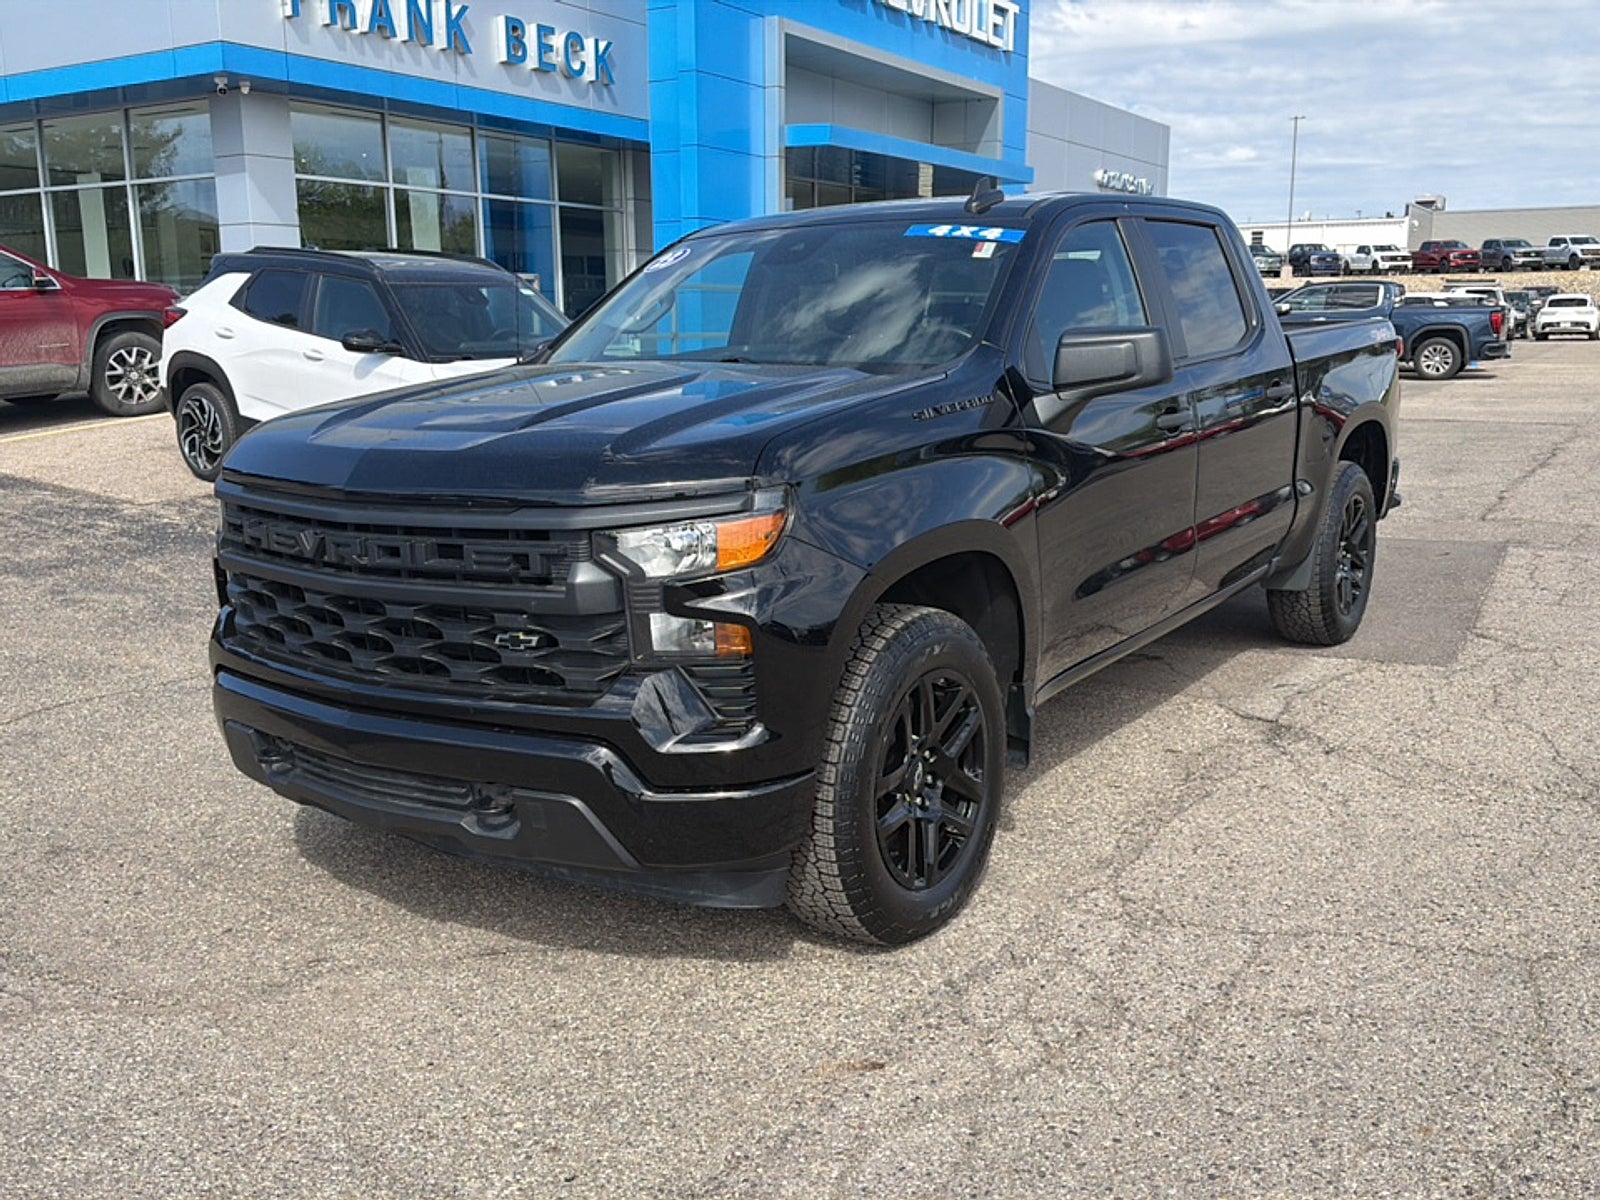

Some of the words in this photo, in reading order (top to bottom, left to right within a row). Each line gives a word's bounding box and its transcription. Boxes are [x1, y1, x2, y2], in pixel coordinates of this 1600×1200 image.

[278, 0, 473, 54] RANK
[499, 15, 614, 86] BECK
[224, 514, 568, 579] CHEVROLET
